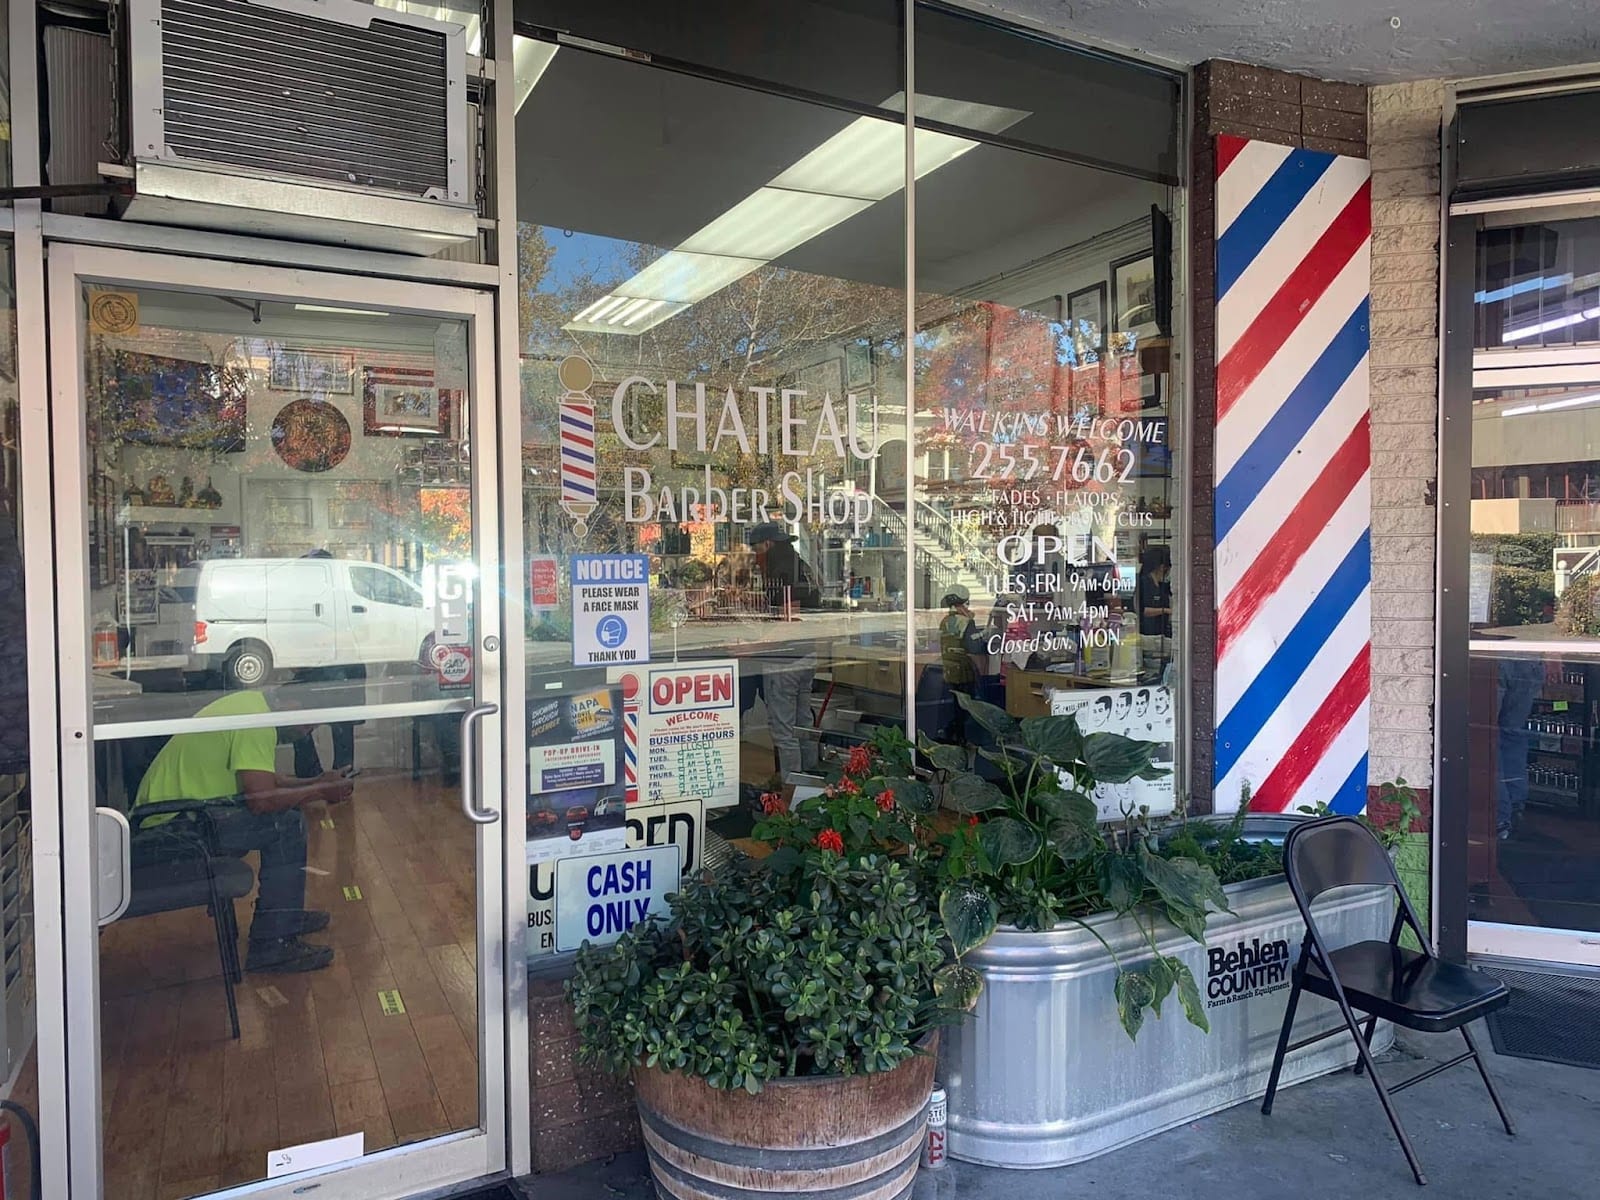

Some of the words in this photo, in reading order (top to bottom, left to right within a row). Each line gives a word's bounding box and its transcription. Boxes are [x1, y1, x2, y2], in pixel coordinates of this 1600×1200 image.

[611, 375, 878, 460] CHATEAU
[1057, 415, 1166, 444] WELCOME
[971, 441, 1136, 484] 255-7662
[992, 489, 1041, 505] FADES
[951, 509, 993, 526] HIGH
[997, 510, 1008, 526] &
[1118, 512, 1153, 527] CUTS
[996, 535, 1118, 566] OPEN
[577, 559, 644, 580] NOTICE
[582, 587, 613, 598] PLEASE
[615, 587, 640, 597] WEAR
[583, 602, 590, 612] A
[591, 601, 612, 612] FACE
[613, 600, 639, 611] MASK
[1006, 602, 1038, 623] SAT.
[1079, 628, 1125, 649] MON.
[588, 651, 617, 662] THANK
[619, 649, 636, 660] YOU
[652, 673, 731, 706] OPEN
[665, 711, 720, 726] WELCOME
[649, 733, 699, 746] BUSINESS
[702, 730, 735, 741] HOURS
[587, 860, 652, 898] CASH
[587, 897, 651, 937] ONLY
[1207, 938, 1289, 977] Behlen
[1207, 960, 1289, 999] COUNTRY
[1207, 1000, 1226, 1008] Farm
[1226, 996, 1232, 1004] &
[1232, 991, 1253, 1002] Ranch
[1255, 982, 1290, 997] Equipment
